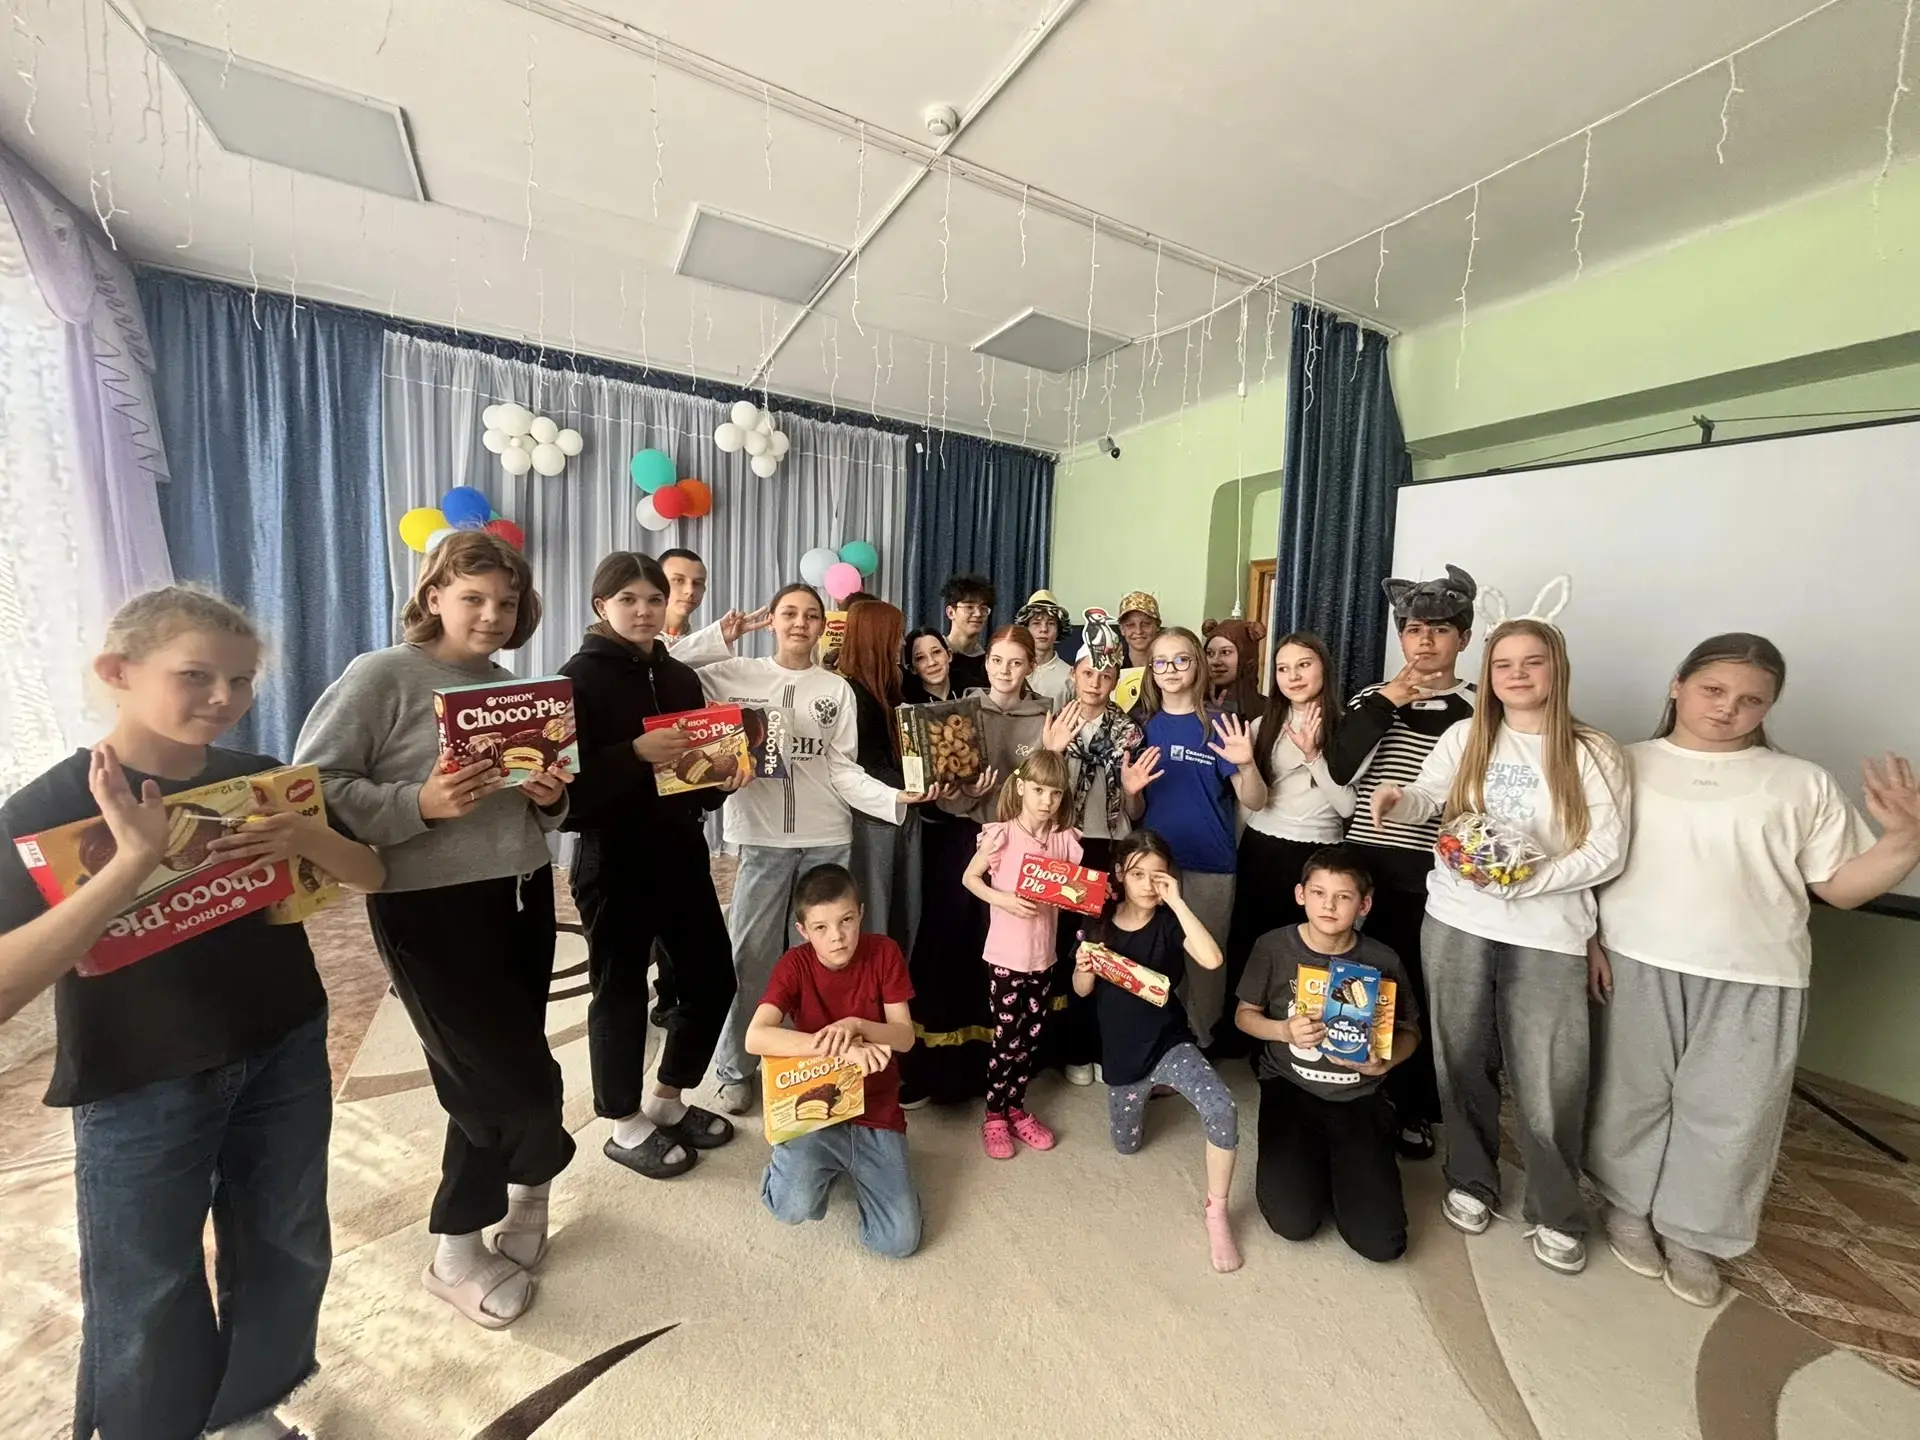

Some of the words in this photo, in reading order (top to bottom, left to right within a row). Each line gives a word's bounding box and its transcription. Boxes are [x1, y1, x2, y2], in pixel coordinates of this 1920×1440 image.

[498, 692, 534, 704] ORION
[687, 718, 709, 727] RION
[1485, 771, 1540, 790] CRUSH
[1022, 863, 1068, 885] Choco
[1019, 877, 1047, 894] Pie
[174, 903, 228, 933] ORION
